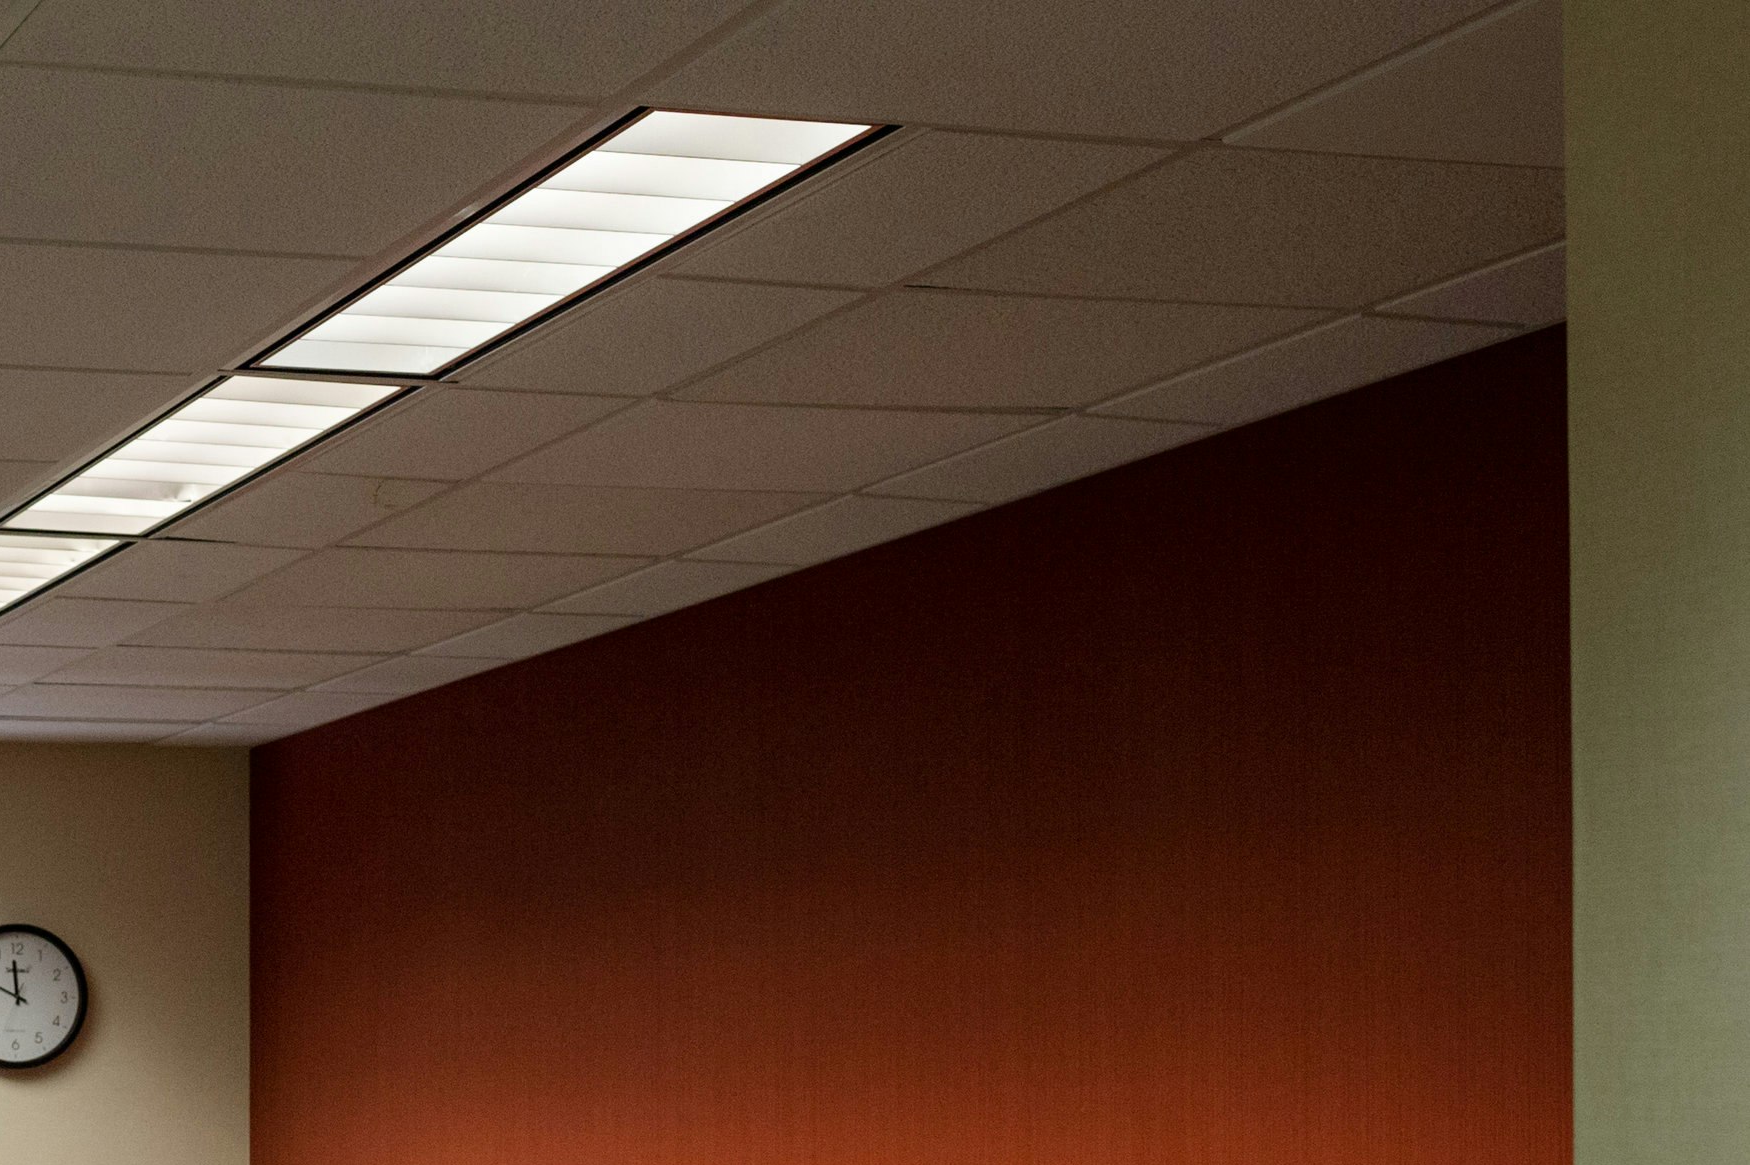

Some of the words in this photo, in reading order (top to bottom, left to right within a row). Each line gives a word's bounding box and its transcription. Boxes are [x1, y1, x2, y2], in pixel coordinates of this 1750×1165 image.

[10, 942, 24, 956] 12
[38, 950, 43, 962] 1
[52, 968, 61, 981] 2
[60, 992, 68, 1004] 3
[52, 1016, 60, 1026] 4
[35, 1032, 43, 1044] 5
[11, 1039, 20, 1050] 6
